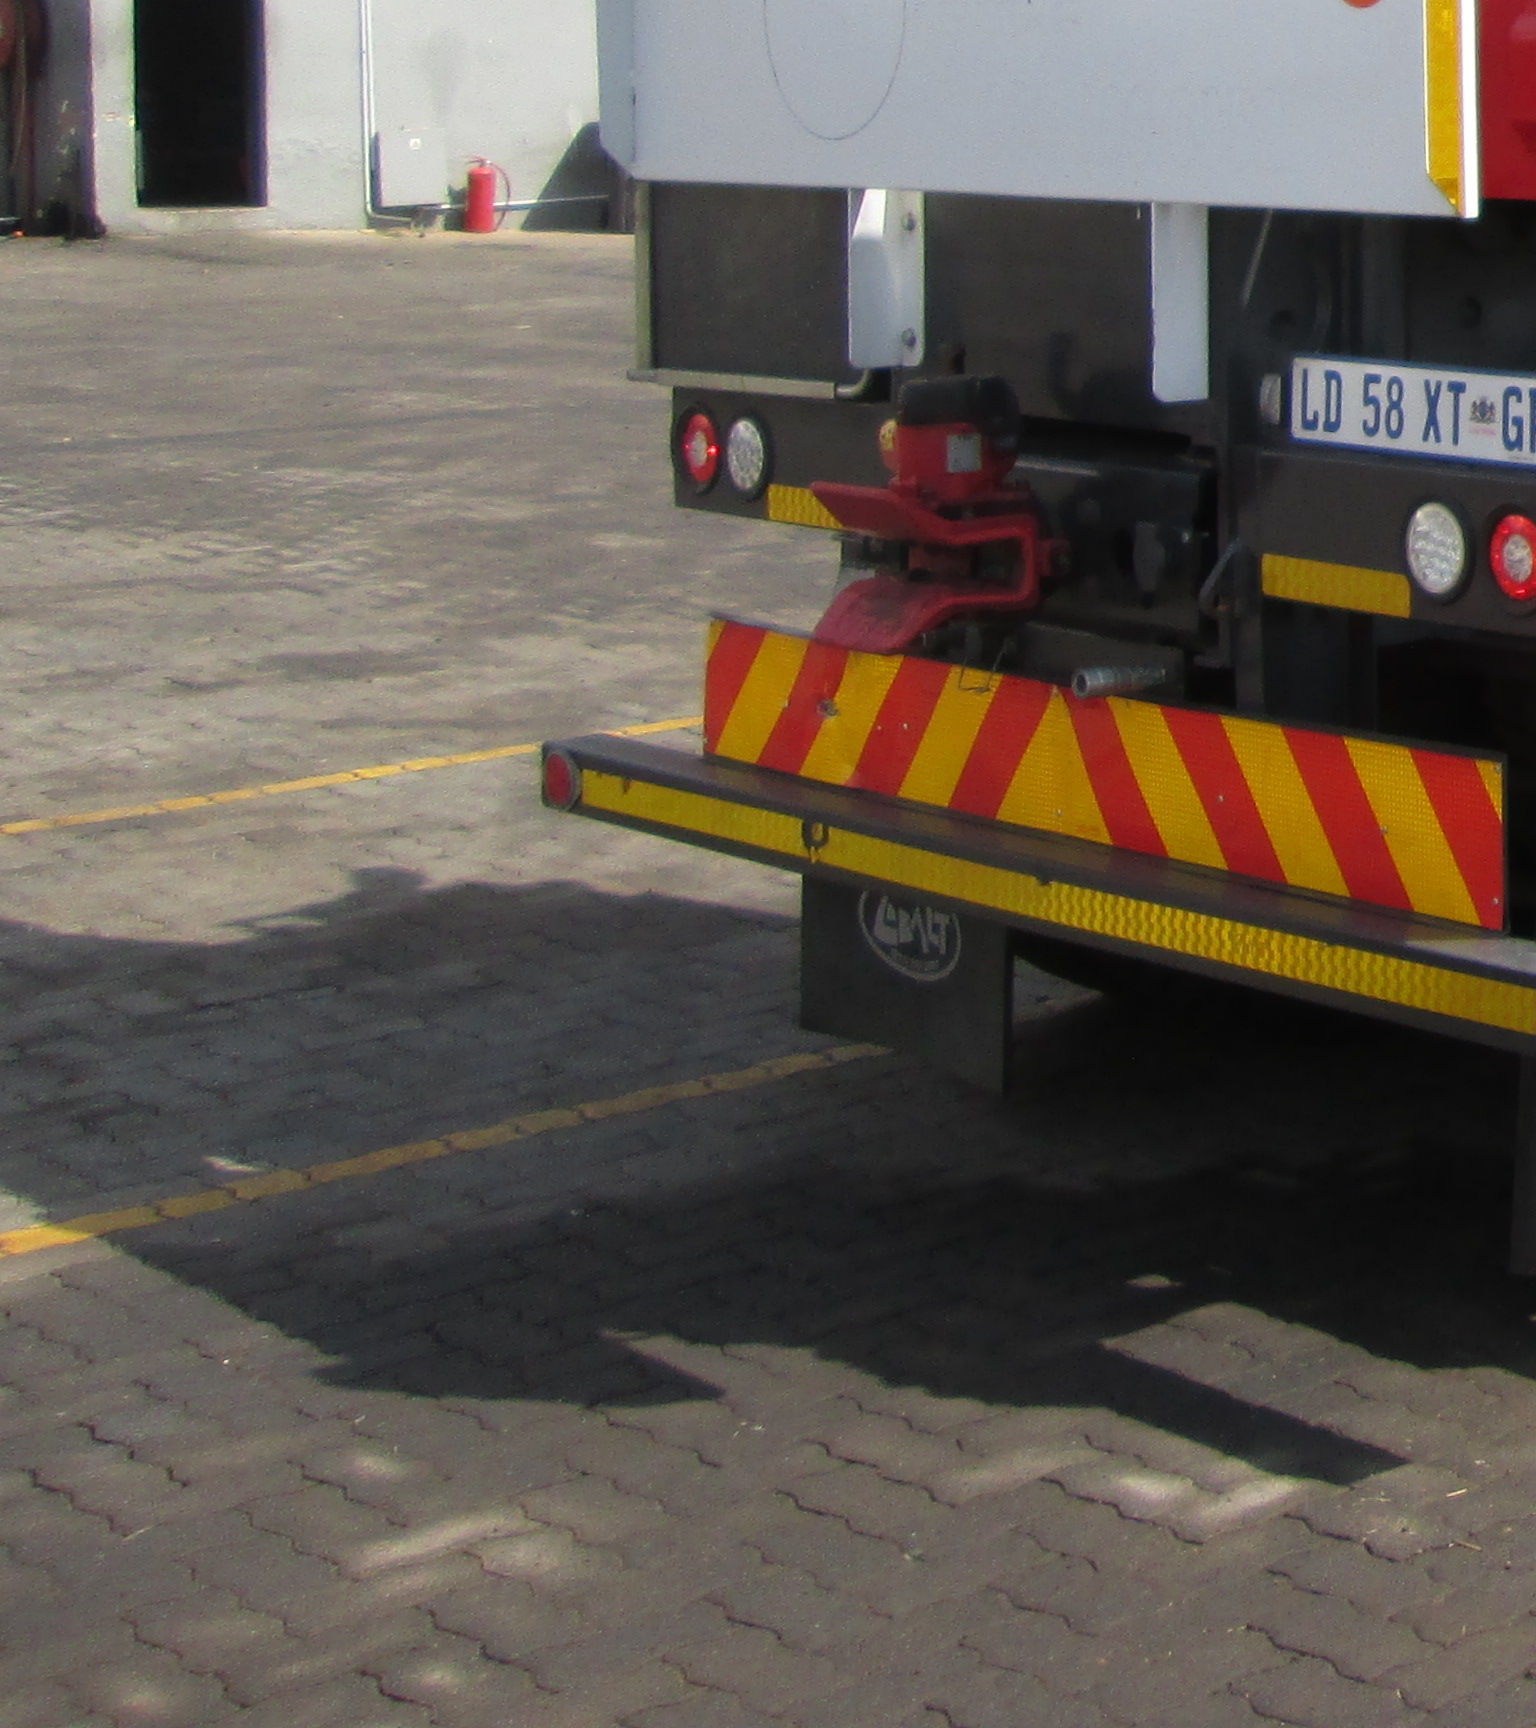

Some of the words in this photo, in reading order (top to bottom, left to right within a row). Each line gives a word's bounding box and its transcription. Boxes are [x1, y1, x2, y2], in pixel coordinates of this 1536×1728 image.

[1300, 367, 1343, 433] LD
[1361, 372, 1405, 440] 58
[1421, 378, 1467, 447] XT
